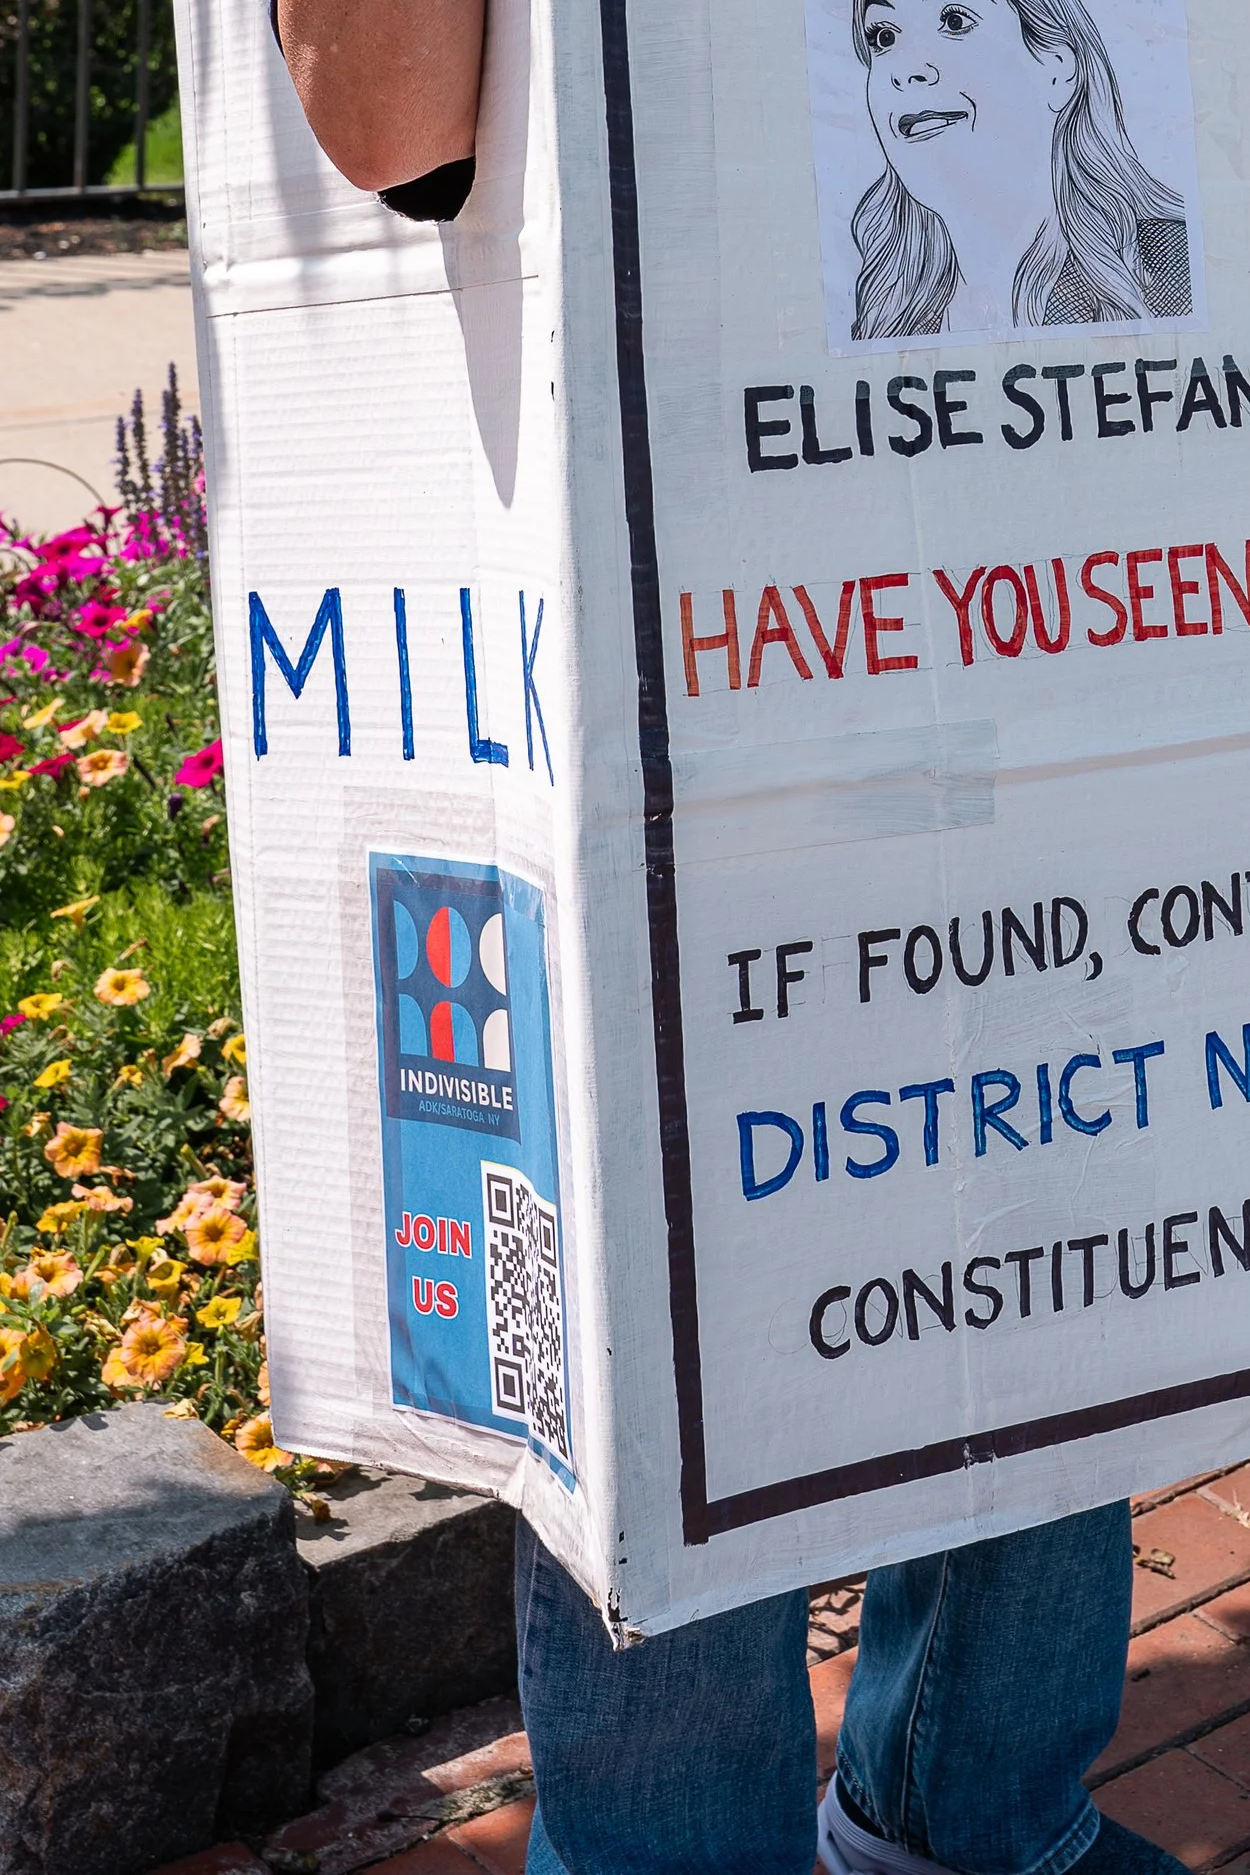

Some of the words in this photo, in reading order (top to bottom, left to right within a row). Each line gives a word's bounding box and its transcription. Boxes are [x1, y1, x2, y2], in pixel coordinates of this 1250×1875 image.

[743, 370, 984, 474] ELISE
[680, 572, 921, 697] HAVE
[932, 557, 1072, 668] YOU
[248, 587, 555, 786] MILK
[727, 940, 815, 1025] IF
[856, 895, 1104, 1004] FOUND,
[400, 1068, 514, 1111] INDIVISIBLE
[418, 1100, 485, 1123] ADK/SARATOGA
[487, 1113, 501, 1126] NY
[736, 1039, 1166, 1203] DISTRICT
[395, 1210, 473, 1260] JOIN
[412, 1275, 459, 1320] US
